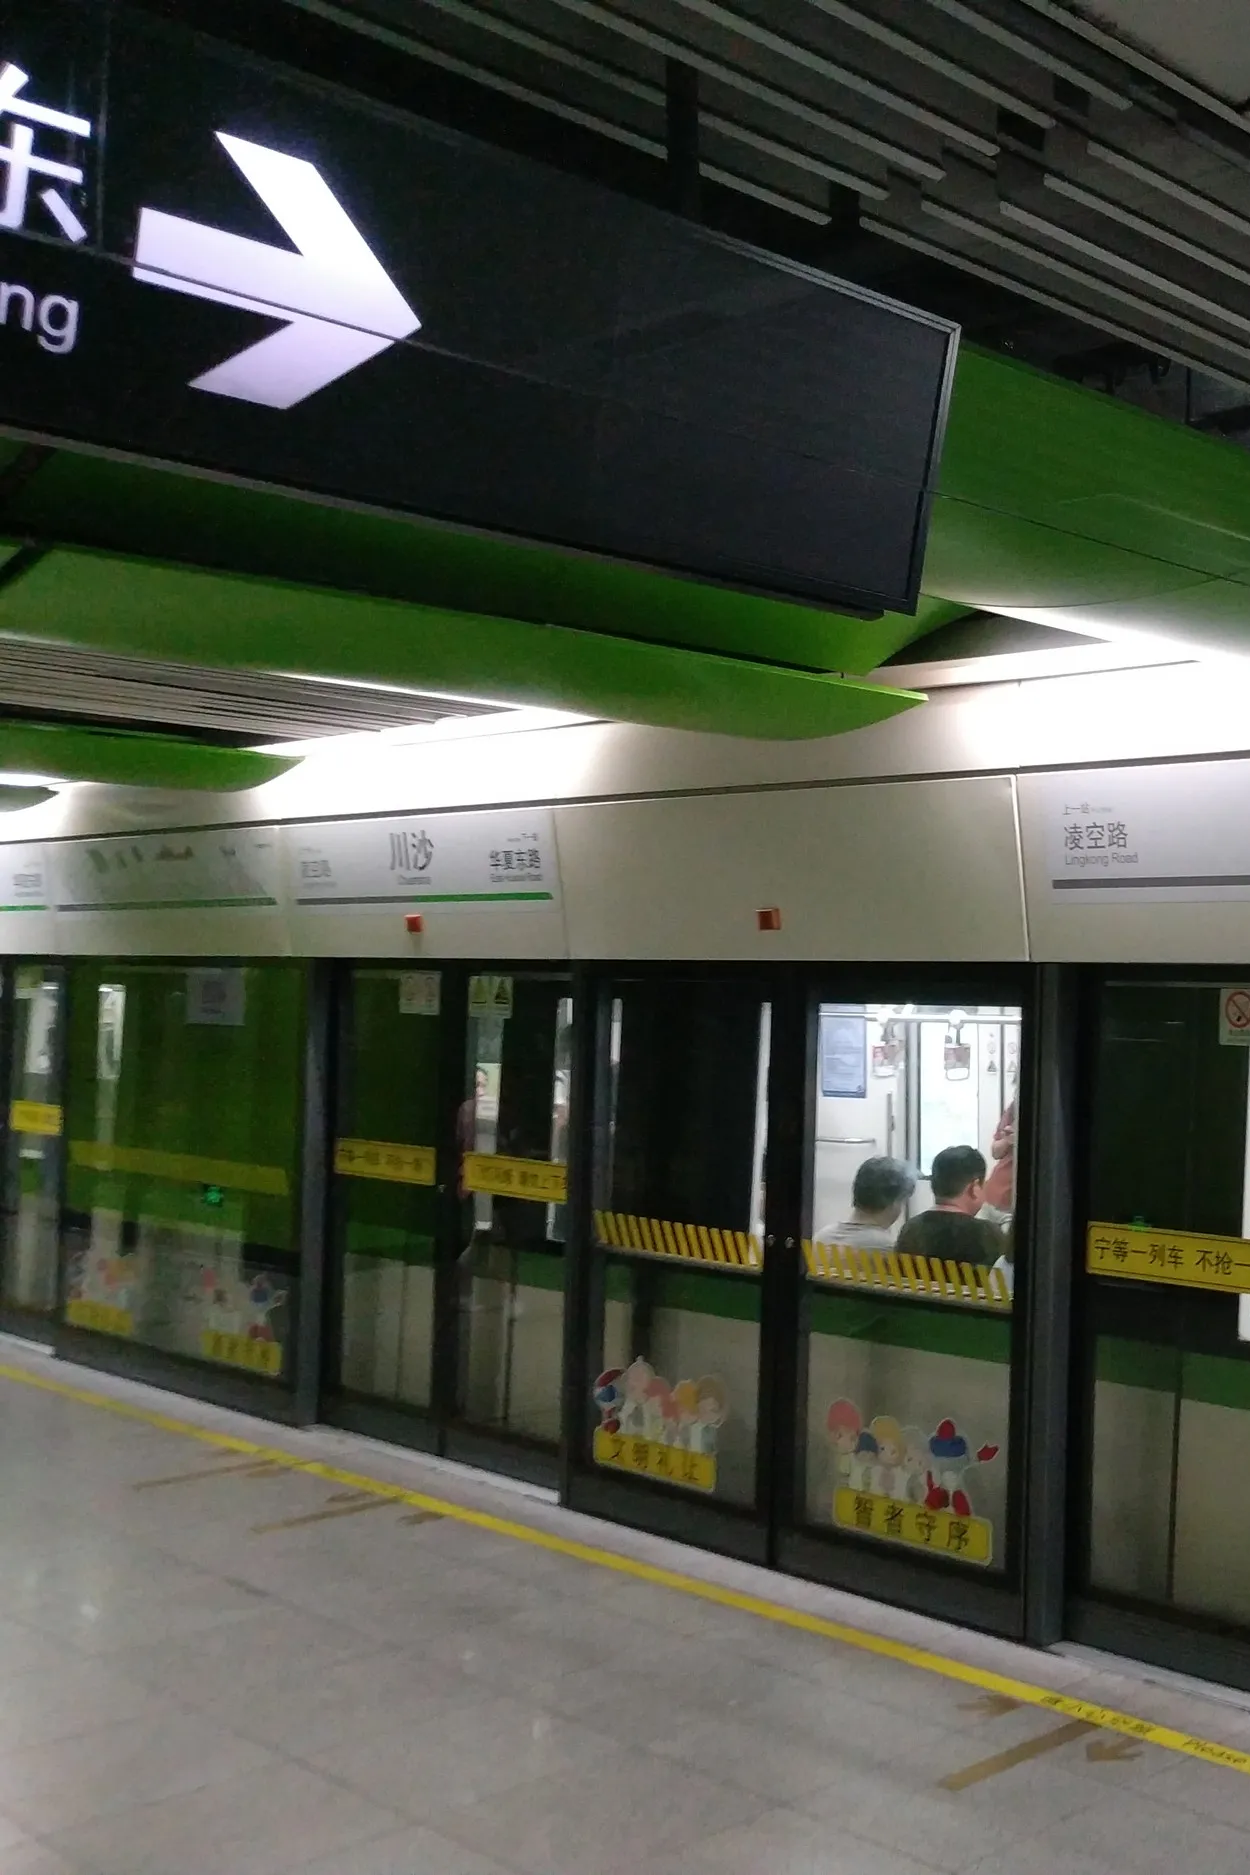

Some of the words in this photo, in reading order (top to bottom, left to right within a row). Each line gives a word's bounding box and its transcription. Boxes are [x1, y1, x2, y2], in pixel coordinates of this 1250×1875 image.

[389, 830, 434, 870] 川沙
[1064, 821, 1128, 850] 凌空路
[1095, 1237, 1185, 1270] 宁等一列车
